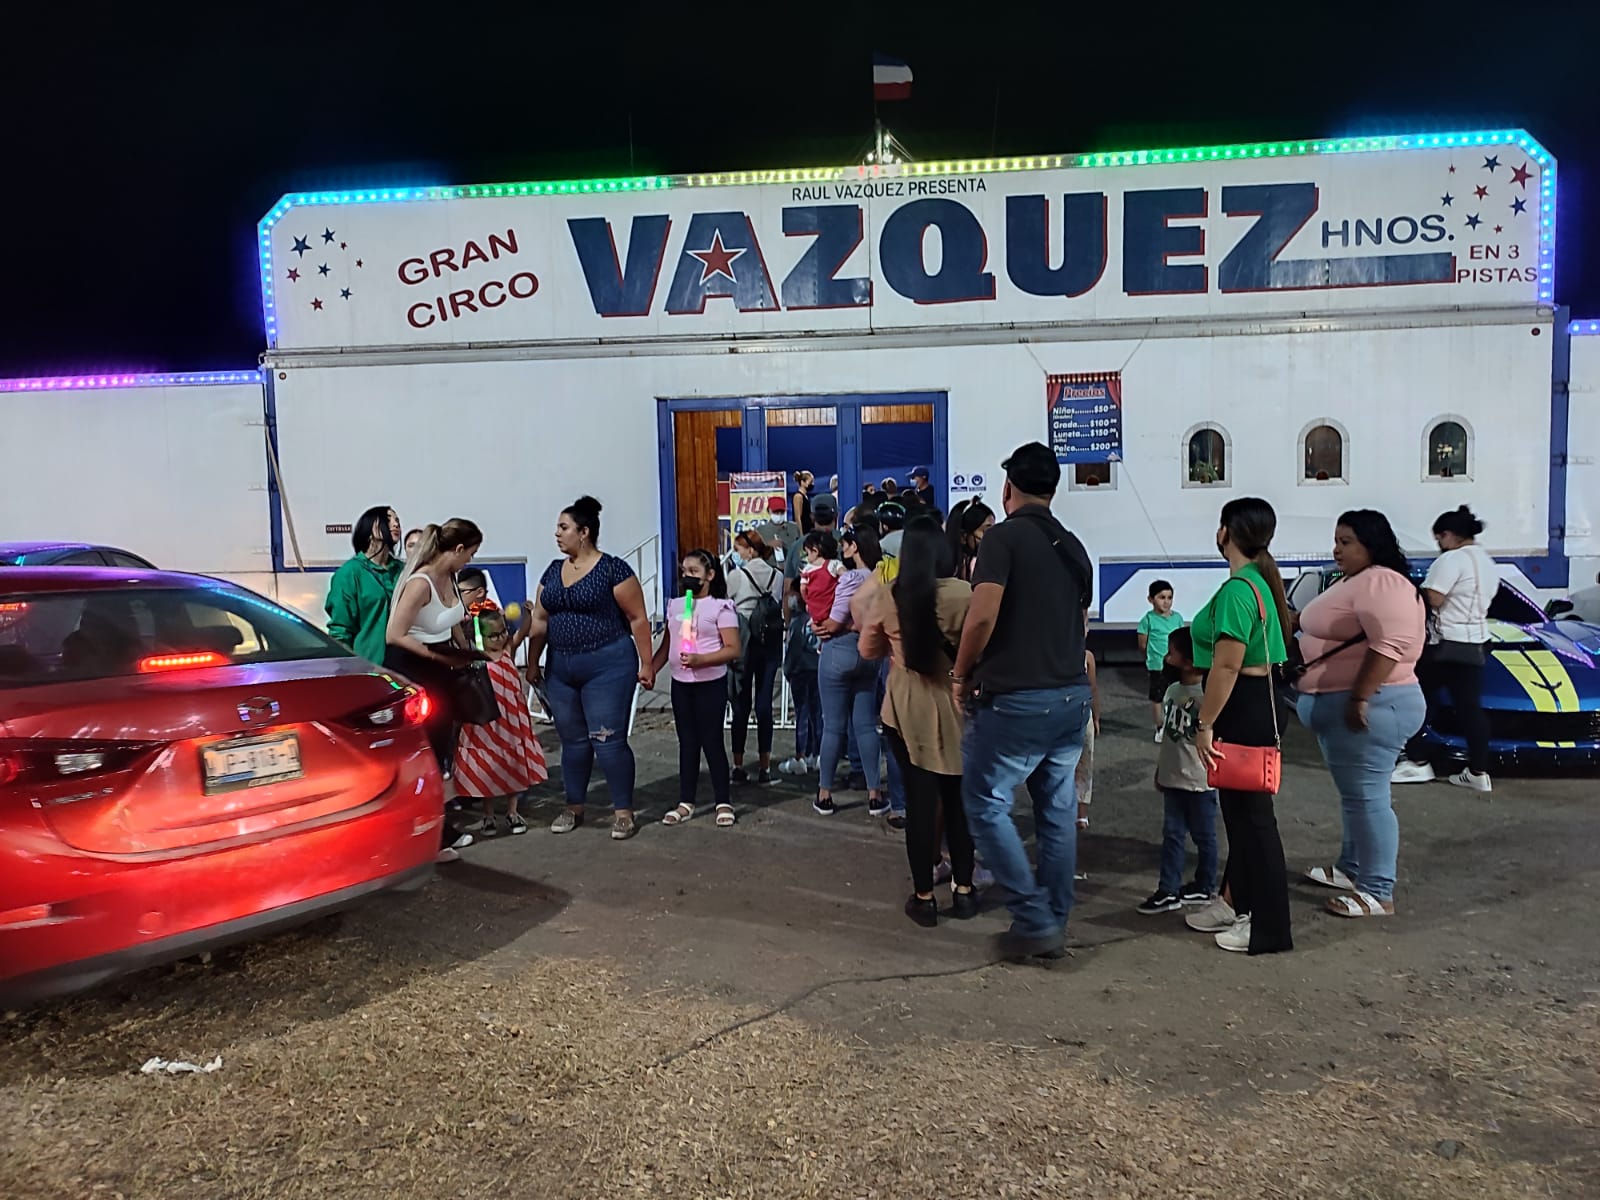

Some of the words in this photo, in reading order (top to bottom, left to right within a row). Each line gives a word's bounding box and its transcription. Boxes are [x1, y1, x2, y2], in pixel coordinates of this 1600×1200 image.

[792, 185, 831, 201] RAUL
[834, 182, 904, 199] VAZQUEZ
[908, 178, 987, 196] PRESENTA
[1321, 214, 1455, 249] HNOS.
[397, 228, 518, 285] GRAN
[566, 182, 1456, 318] VAZQUEZ
[1469, 244, 1500, 260] EN
[1507, 244, 1521, 260] 3
[1456, 266, 1538, 283] PISTAS
[407, 272, 539, 328] CIRCO
